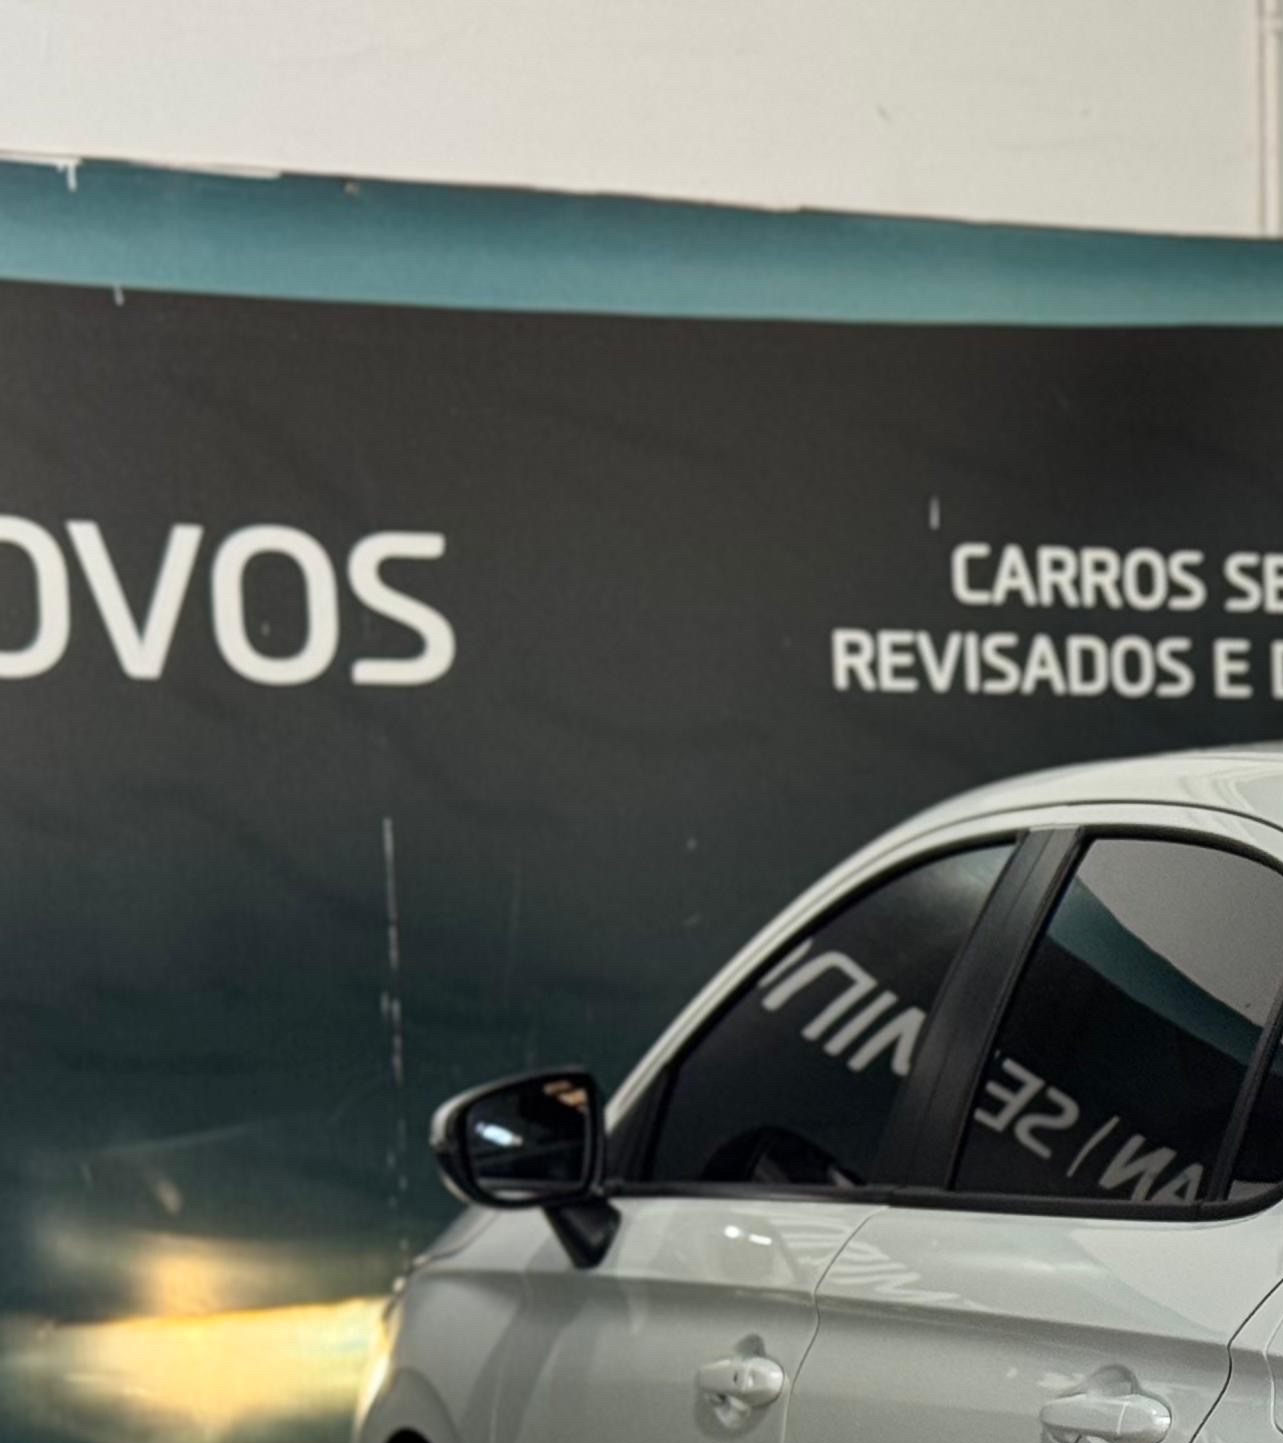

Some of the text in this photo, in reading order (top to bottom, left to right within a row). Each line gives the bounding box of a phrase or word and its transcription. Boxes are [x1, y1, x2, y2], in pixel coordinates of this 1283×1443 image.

[951, 542, 1207, 611] CARROS
[830, 627, 1194, 698] REVISADOS
[1213, 638, 1252, 699] E
